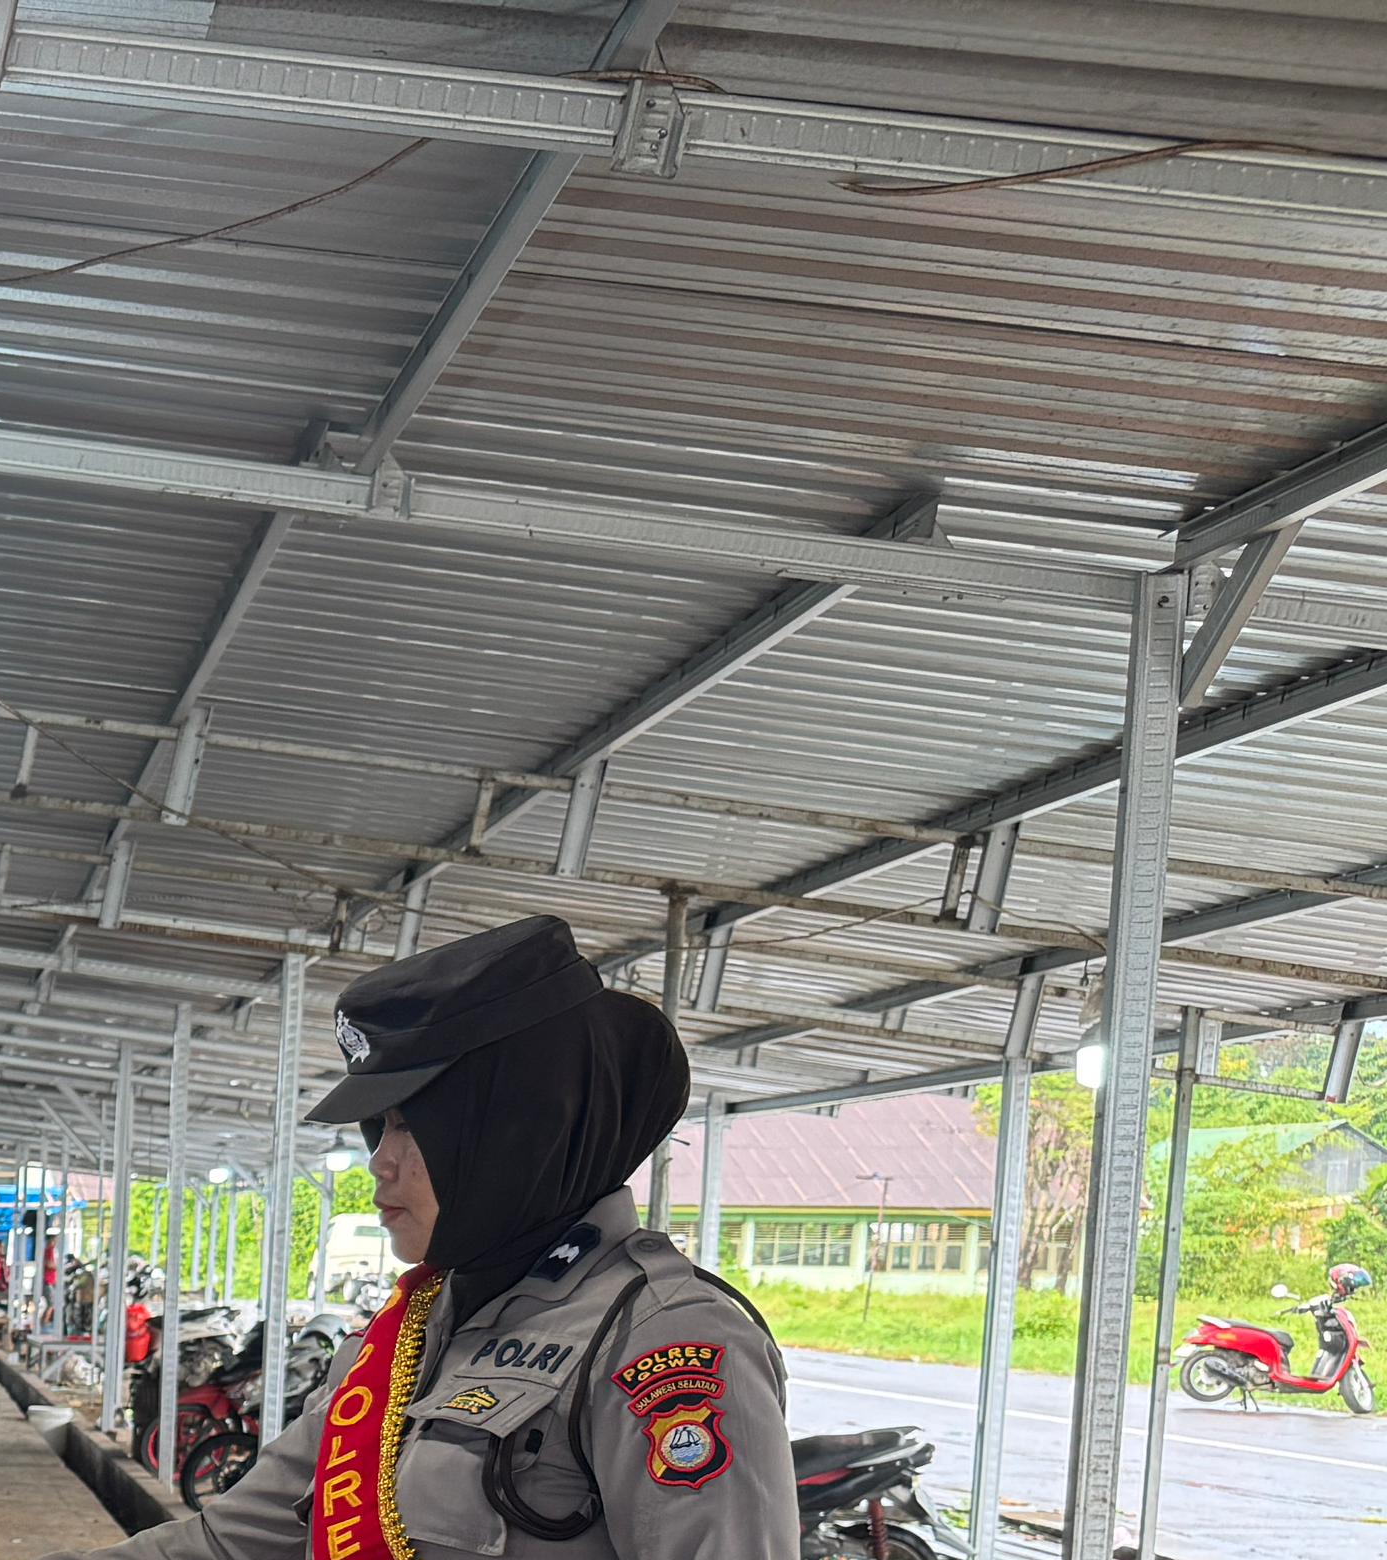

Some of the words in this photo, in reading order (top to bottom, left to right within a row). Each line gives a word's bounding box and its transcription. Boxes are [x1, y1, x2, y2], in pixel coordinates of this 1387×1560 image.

[470, 1338, 574, 1374] POLRI
[622, 1346, 712, 1382] POLRES
[638, 1358, 701, 1382] GOWA
[635, 1382, 677, 1411] SULAWESI
[677, 1379, 718, 1393] SELATAN
